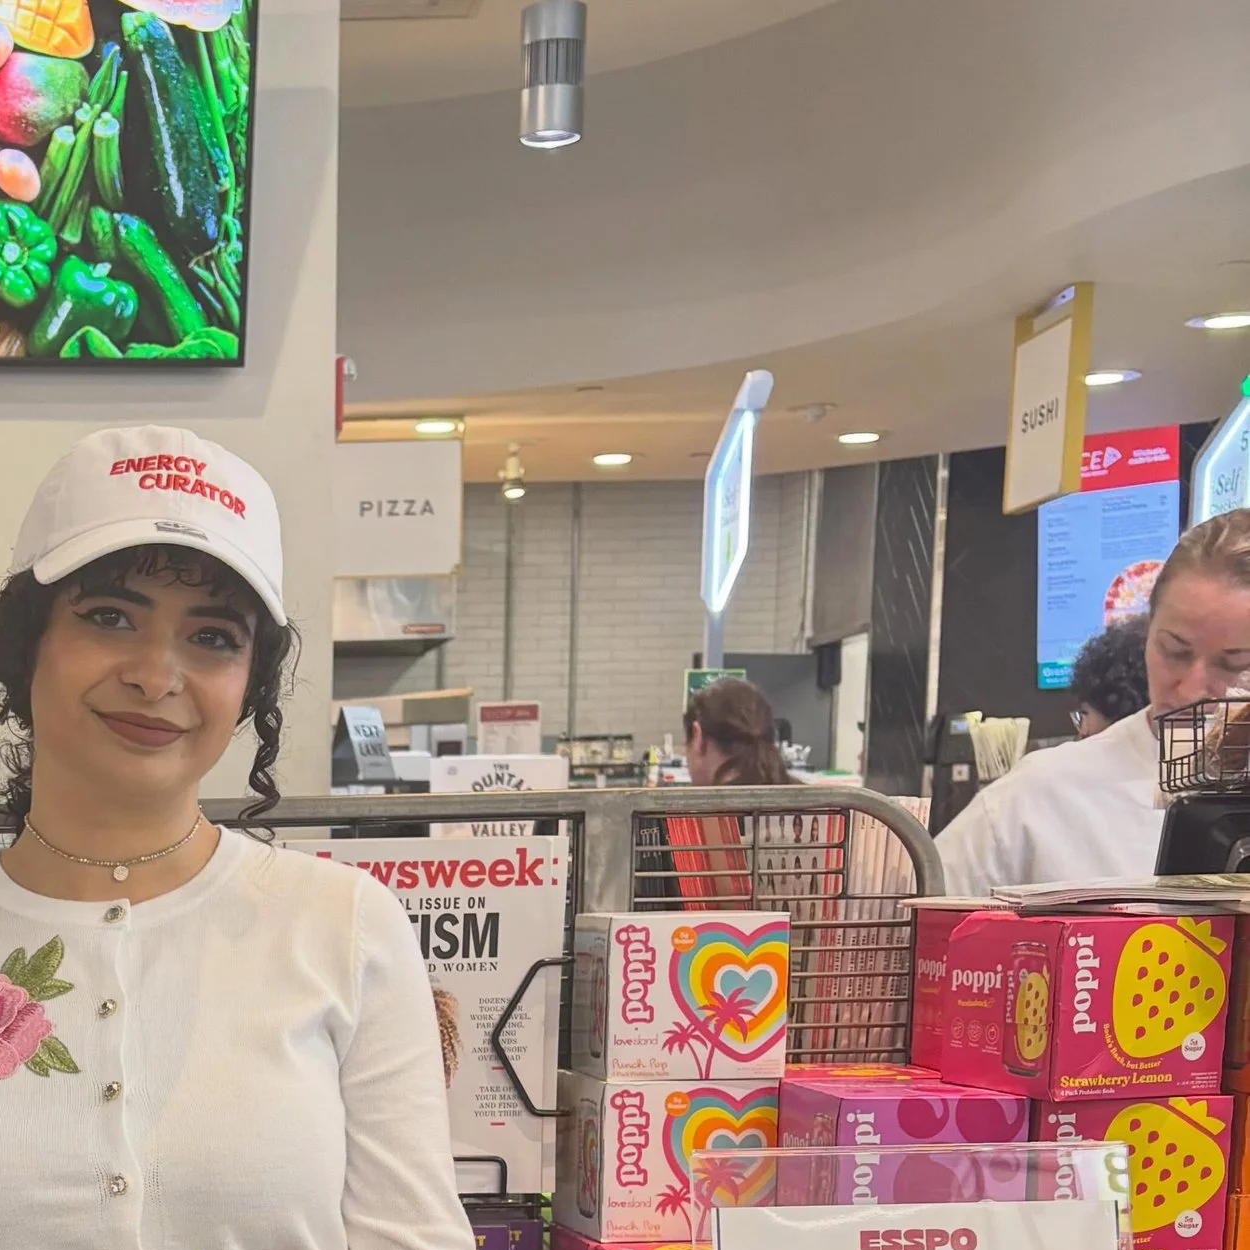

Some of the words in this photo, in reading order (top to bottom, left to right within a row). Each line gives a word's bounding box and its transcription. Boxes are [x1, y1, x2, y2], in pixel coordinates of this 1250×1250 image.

[1021, 395, 1059, 434] SUSHI
[110, 454, 207, 476] ENERGY
[139, 473, 246, 520] CURATOR
[359, 497, 436, 518] PIZZA
[353, 724, 380, 739] NEXT
[358, 743, 386, 757] LANE
[471, 822, 527, 837] VALLEY
[356, 847, 544, 889] wsweek
[419, 897, 460, 910] ISSUE
[468, 896, 486, 908] ON
[443, 962, 498, 972] WOMEN
[615, 924, 656, 1025] poppi
[951, 964, 1004, 994] poppi
[1068, 933, 1100, 1035] poppi
[1184, 1044, 1204, 1053] Sugar
[1060, 1074, 1131, 1089] Strawberry
[1132, 1072, 1173, 1084] Lemon
[610, 1089, 650, 1187] poppi
[1177, 1222, 1199, 1230] Sugar
